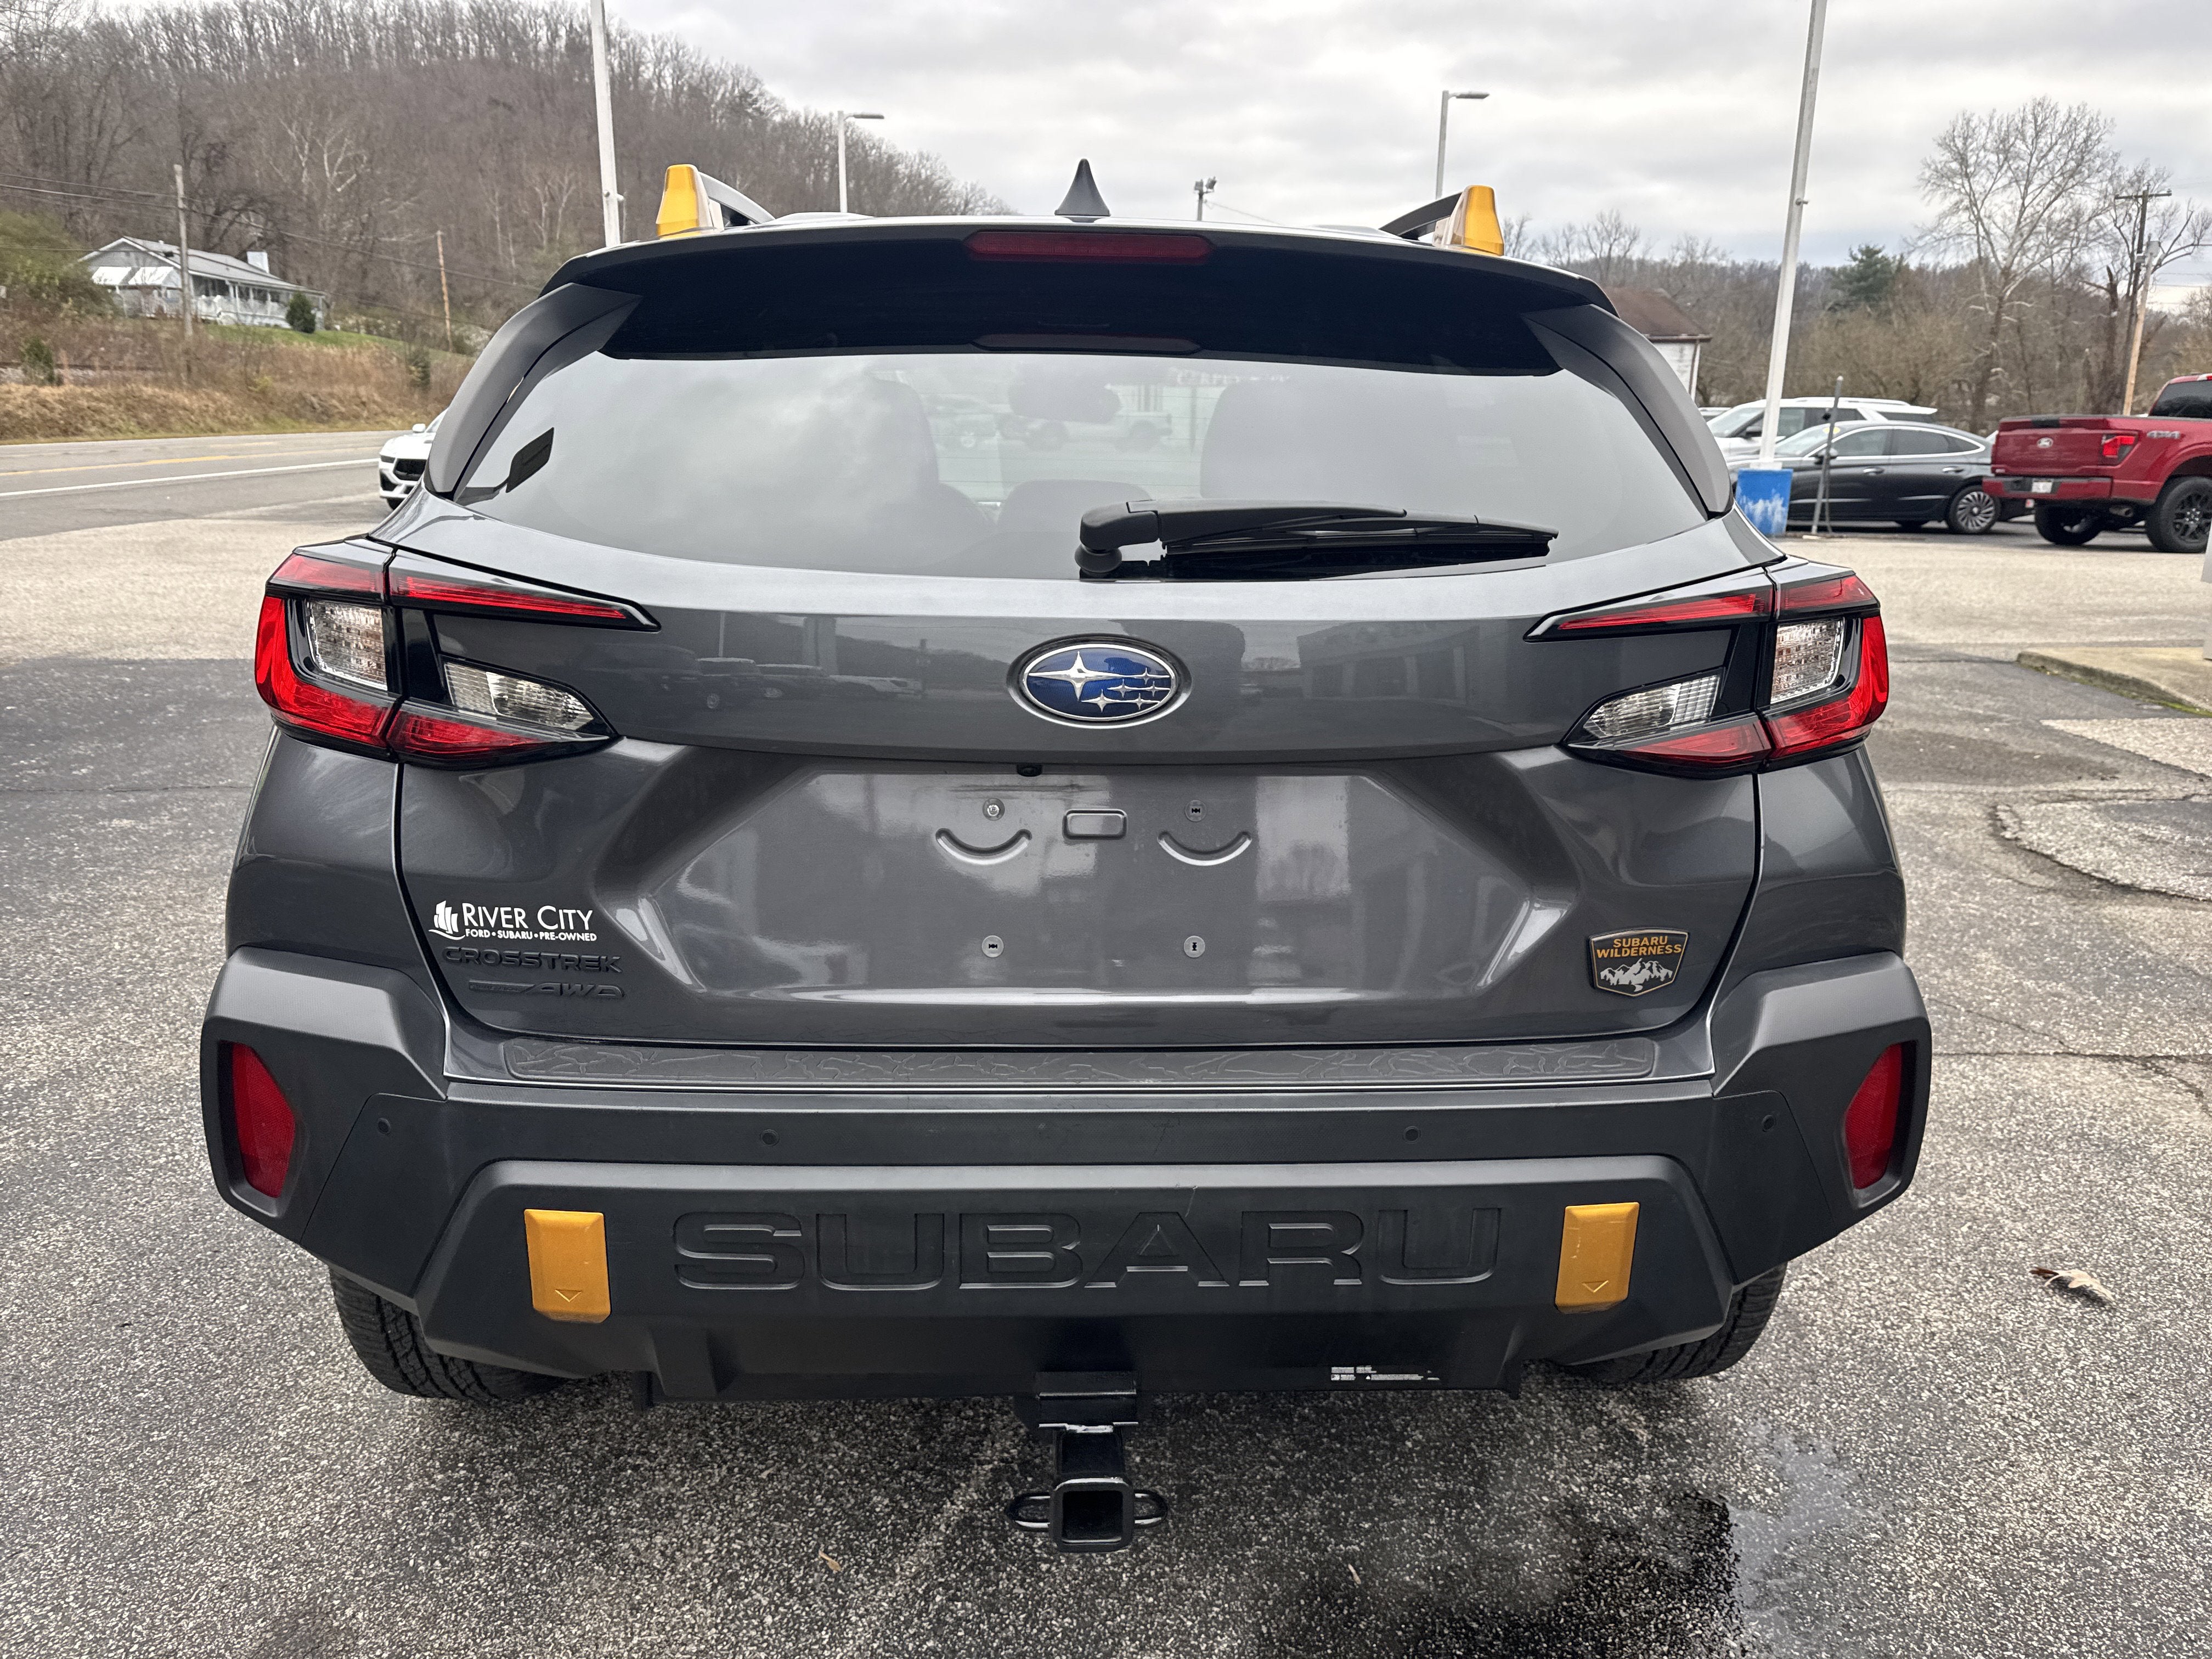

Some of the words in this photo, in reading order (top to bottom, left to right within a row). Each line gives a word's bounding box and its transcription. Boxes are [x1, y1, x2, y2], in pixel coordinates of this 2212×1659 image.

[462, 902, 529, 929] RIVER
[537, 905, 593, 930] CITY
[465, 929, 490, 938] FORD
[497, 930, 533, 940] SUBARU
[539, 931, 597, 941] PRE-OWNED
[1613, 936, 1668, 947] SUBARU
[443, 946, 623, 973] CROSSTREK
[1597, 945, 1681, 958] WILDERNESS
[525, 981, 626, 998] AWD
[672, 1206, 1502, 1291] SUBARU
